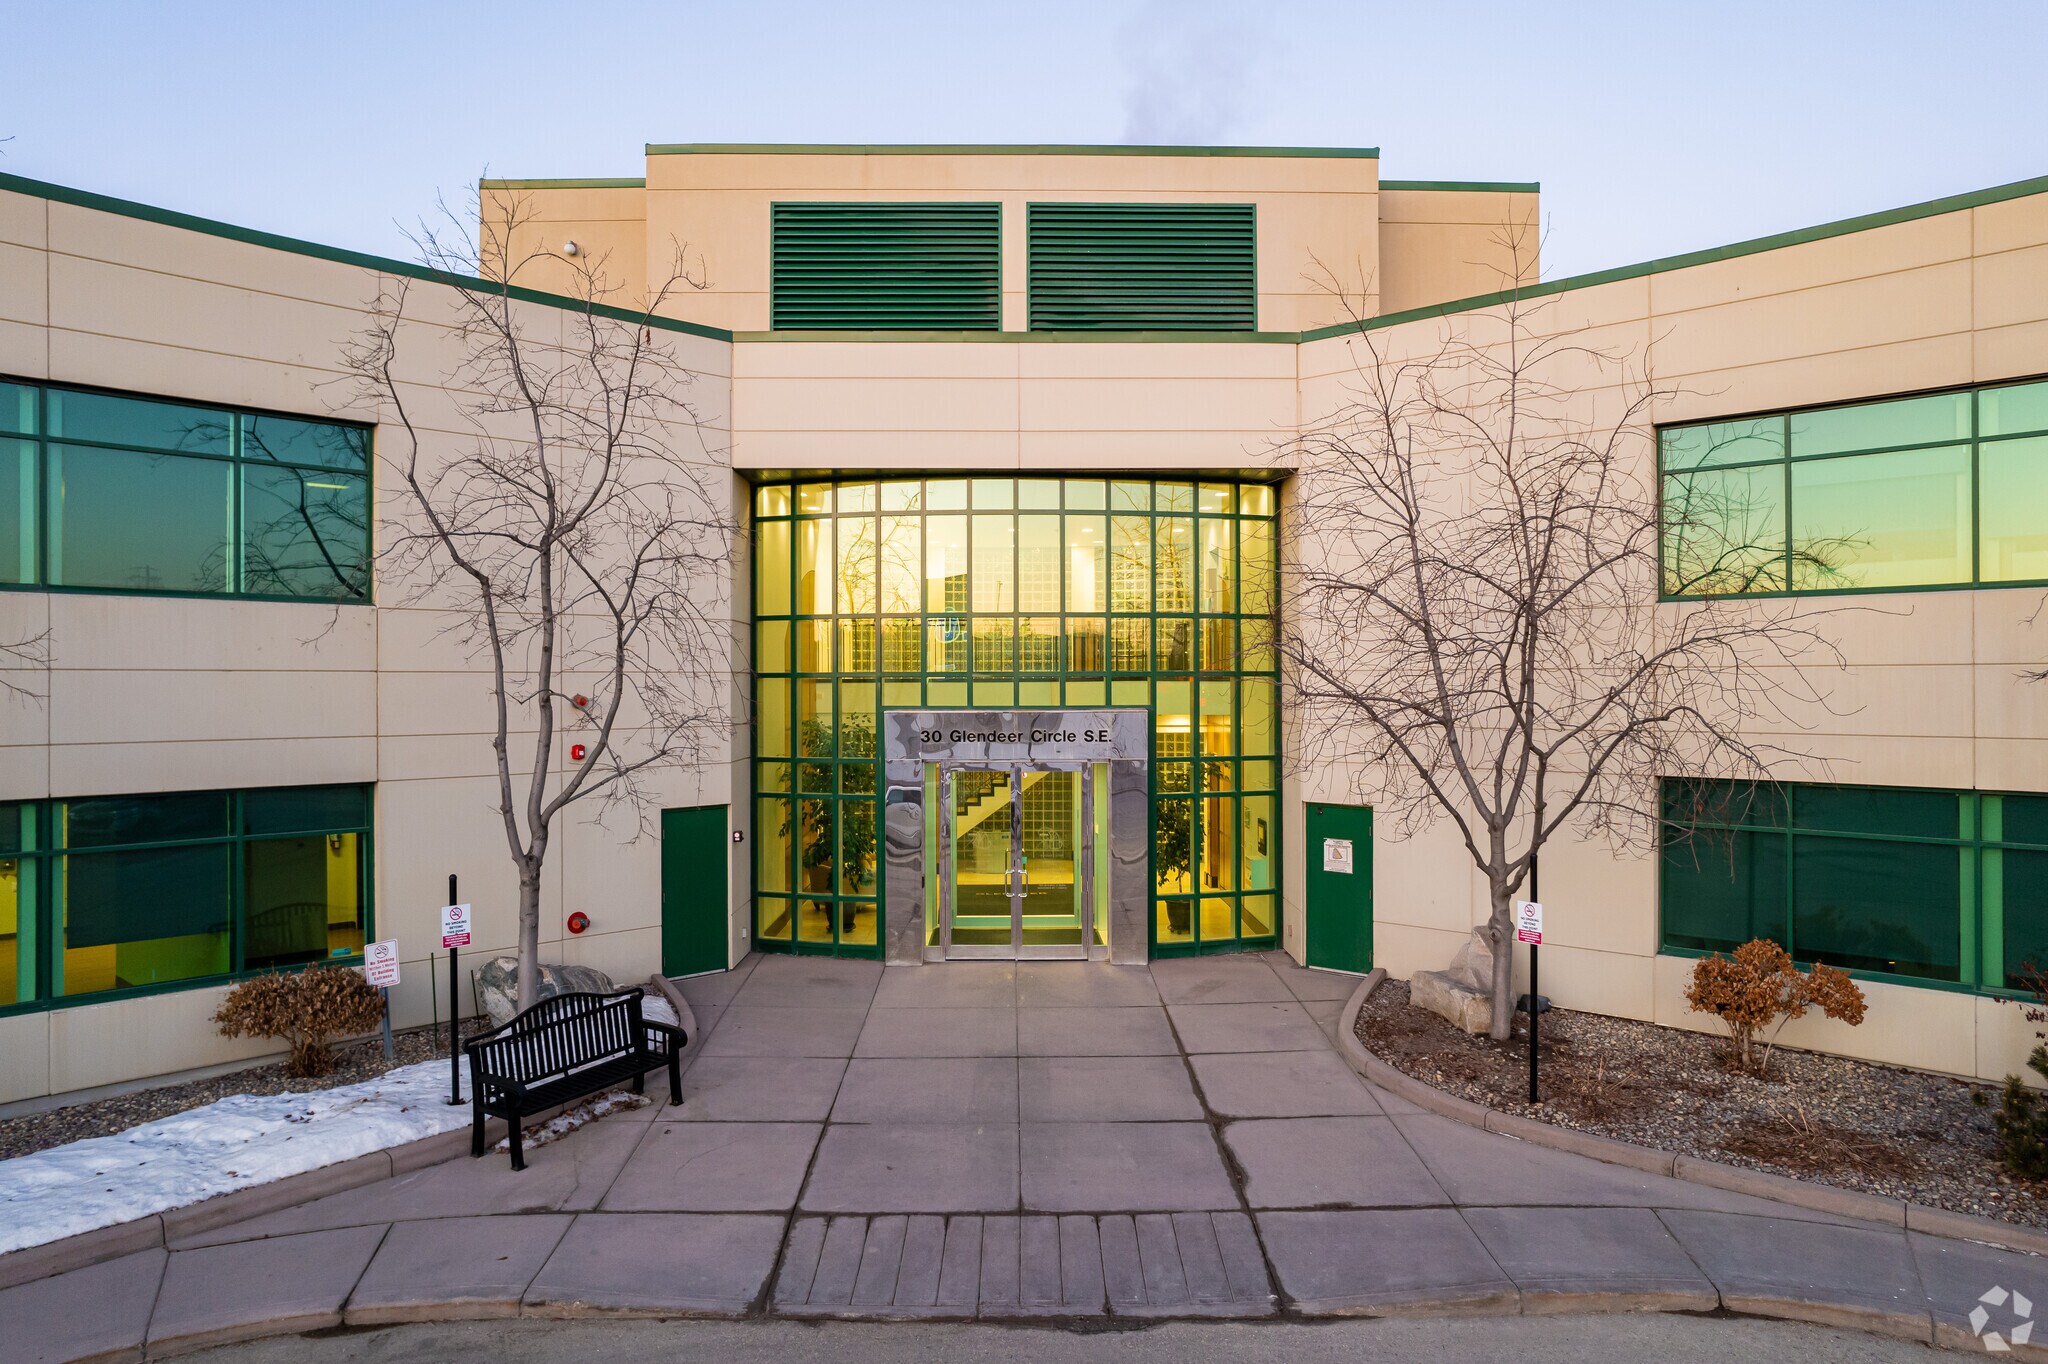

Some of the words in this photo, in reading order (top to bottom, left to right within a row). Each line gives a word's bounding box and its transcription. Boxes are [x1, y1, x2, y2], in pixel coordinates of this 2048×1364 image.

[920, 729, 942, 743] 30
[950, 729, 1023, 743] Glendeer
[1031, 729, 1076, 743] Circle
[1084, 729, 1112, 743] S.E.
